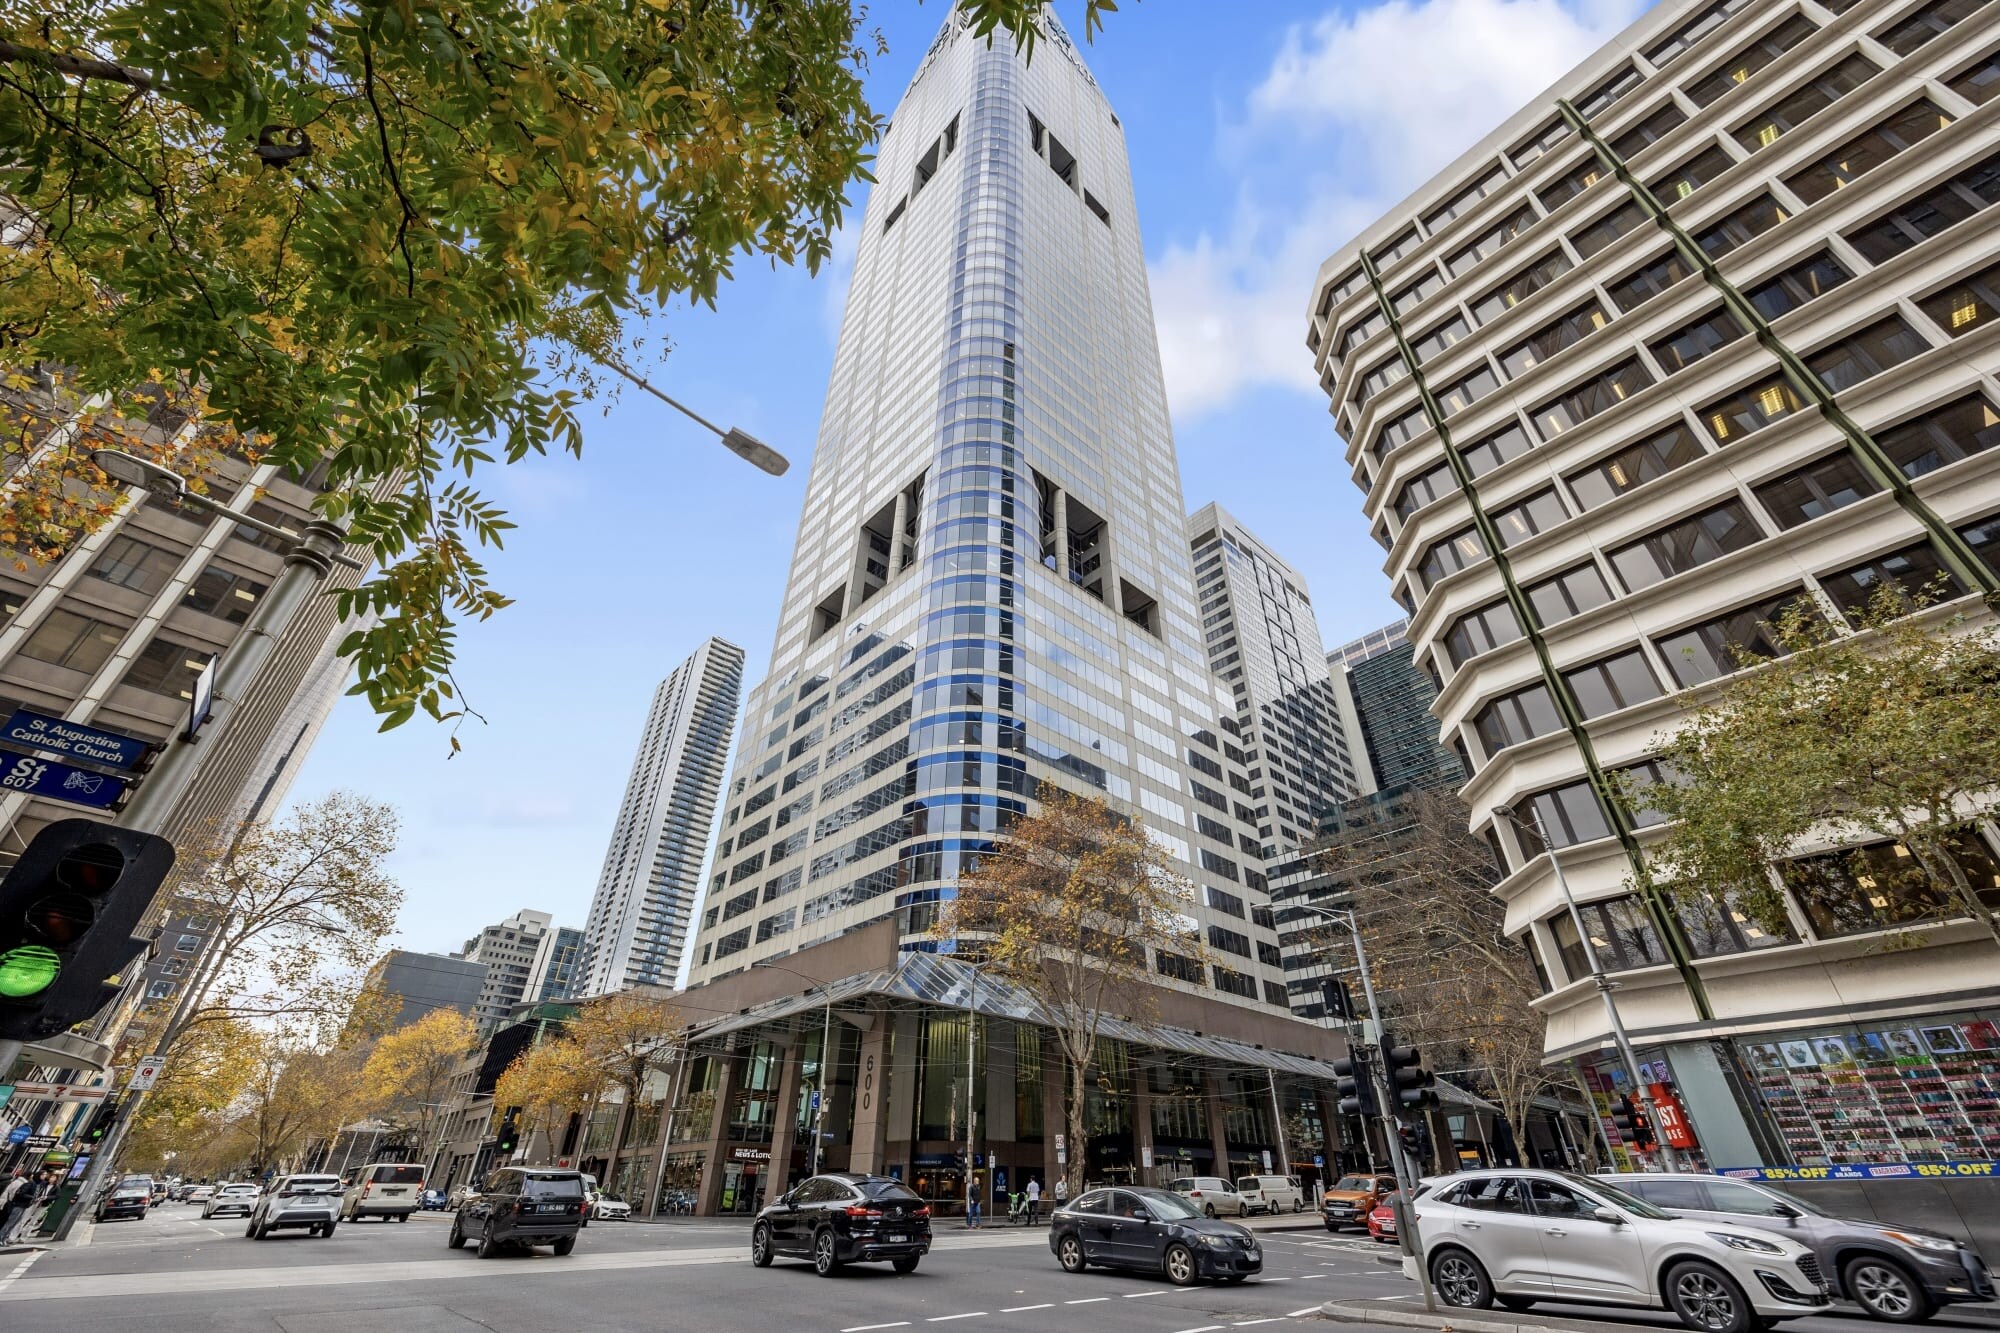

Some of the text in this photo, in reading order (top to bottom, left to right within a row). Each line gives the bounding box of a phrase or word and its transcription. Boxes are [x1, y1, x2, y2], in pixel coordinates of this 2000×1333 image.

[11, 728, 123, 763] Catholic Church
[30, 719, 121, 750] St Augustine
[11, 758, 47, 780] St
[3, 775, 38, 790] 607
[863, 1054, 874, 1110] 600
[1656, 1105, 1678, 1127] IST
[1765, 1168, 1798, 1179] 85%
[1798, 1167, 1829, 1179] OFF
[1917, 1164, 1956, 1176] 85%
[1957, 1163, 1992, 1175] OFF
